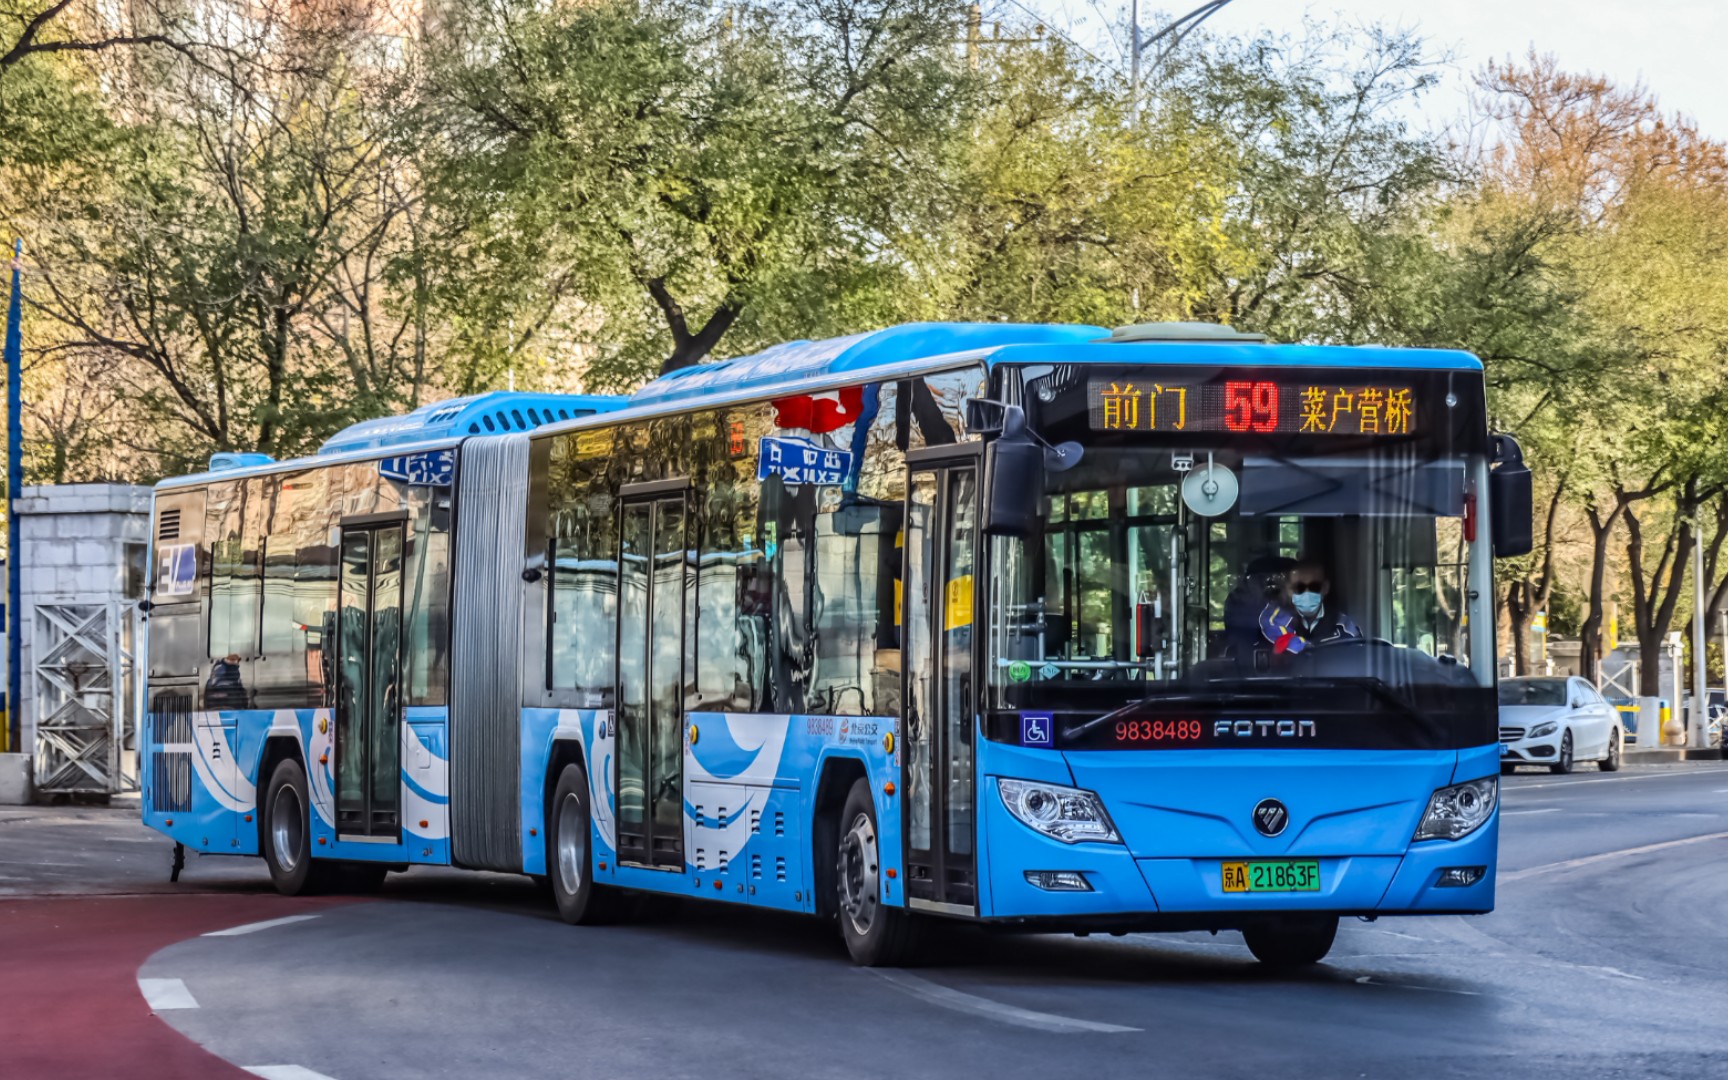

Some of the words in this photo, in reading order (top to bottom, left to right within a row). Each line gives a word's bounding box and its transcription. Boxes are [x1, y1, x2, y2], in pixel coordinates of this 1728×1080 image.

[1101, 382, 1187, 430] 前门
[1224, 380, 1278, 432] 59
[1300, 386, 1413, 434] 菜户营桥
[1115, 720, 1201, 741] 9838489
[1213, 720, 1316, 737] FOTON
